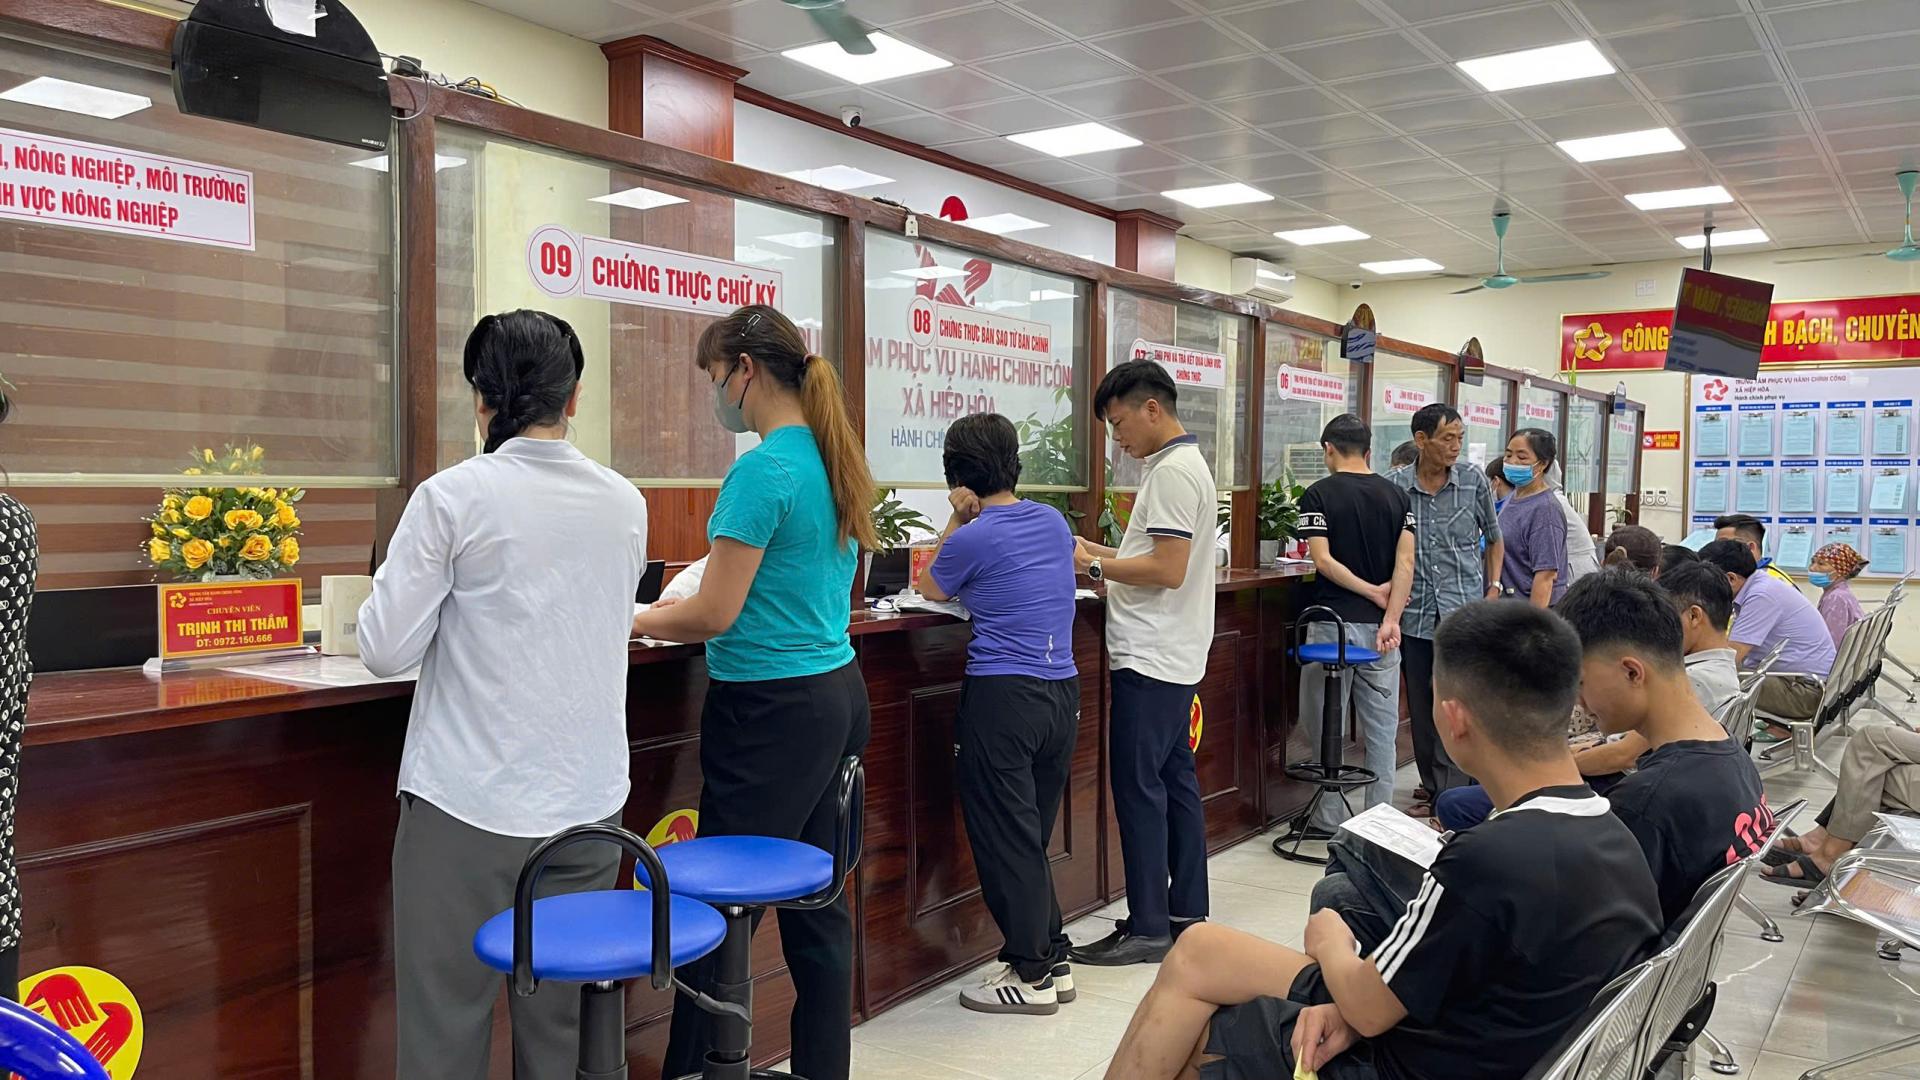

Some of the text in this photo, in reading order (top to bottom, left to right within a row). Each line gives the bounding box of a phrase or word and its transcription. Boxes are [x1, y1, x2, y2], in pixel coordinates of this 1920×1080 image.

[14, 144, 66, 176] NÔNG
[146, 166, 178, 194] MÔI
[183, 174, 246, 204] TRƯỜNG
[20, 185, 56, 216] VỰC
[62, 189, 112, 220] NÔNG
[117, 200, 179, 232] NGHIỆP
[540, 241, 573, 278] 09
[592, 253, 776, 307] CHỨNG THỰC CHỮ KÝ
[913, 308, 931, 335] 08
[939, 316, 963, 340] CHỨNG
[964, 322, 980, 345] THỰC
[981, 320, 995, 344] BẢN
[996, 328, 1009, 347] SAO
[1018, 327, 1031, 350] BẢN
[1031, 333, 1049, 353] CHÍNH
[1622, 322, 1669, 352] CÔNG
[1782, 315, 1839, 351] BẠCH,
[1845, 308, 1920, 343] CHUYÊN
[888, 339, 932, 379] PHỤC
[935, 349, 957, 383] VỤ
[1280, 373, 1289, 389] 06
[1384, 389, 1392, 404] 05
[903, 383, 926, 416] XÃ
[891, 425, 923, 449] HÀNH
[207, 604, 261, 615] CHUYÊN VIÊN
[177, 620, 221, 638] TRỊNH
[224, 619, 247, 635] THỊ
[213, 633, 273, 646] 0972.150.666
